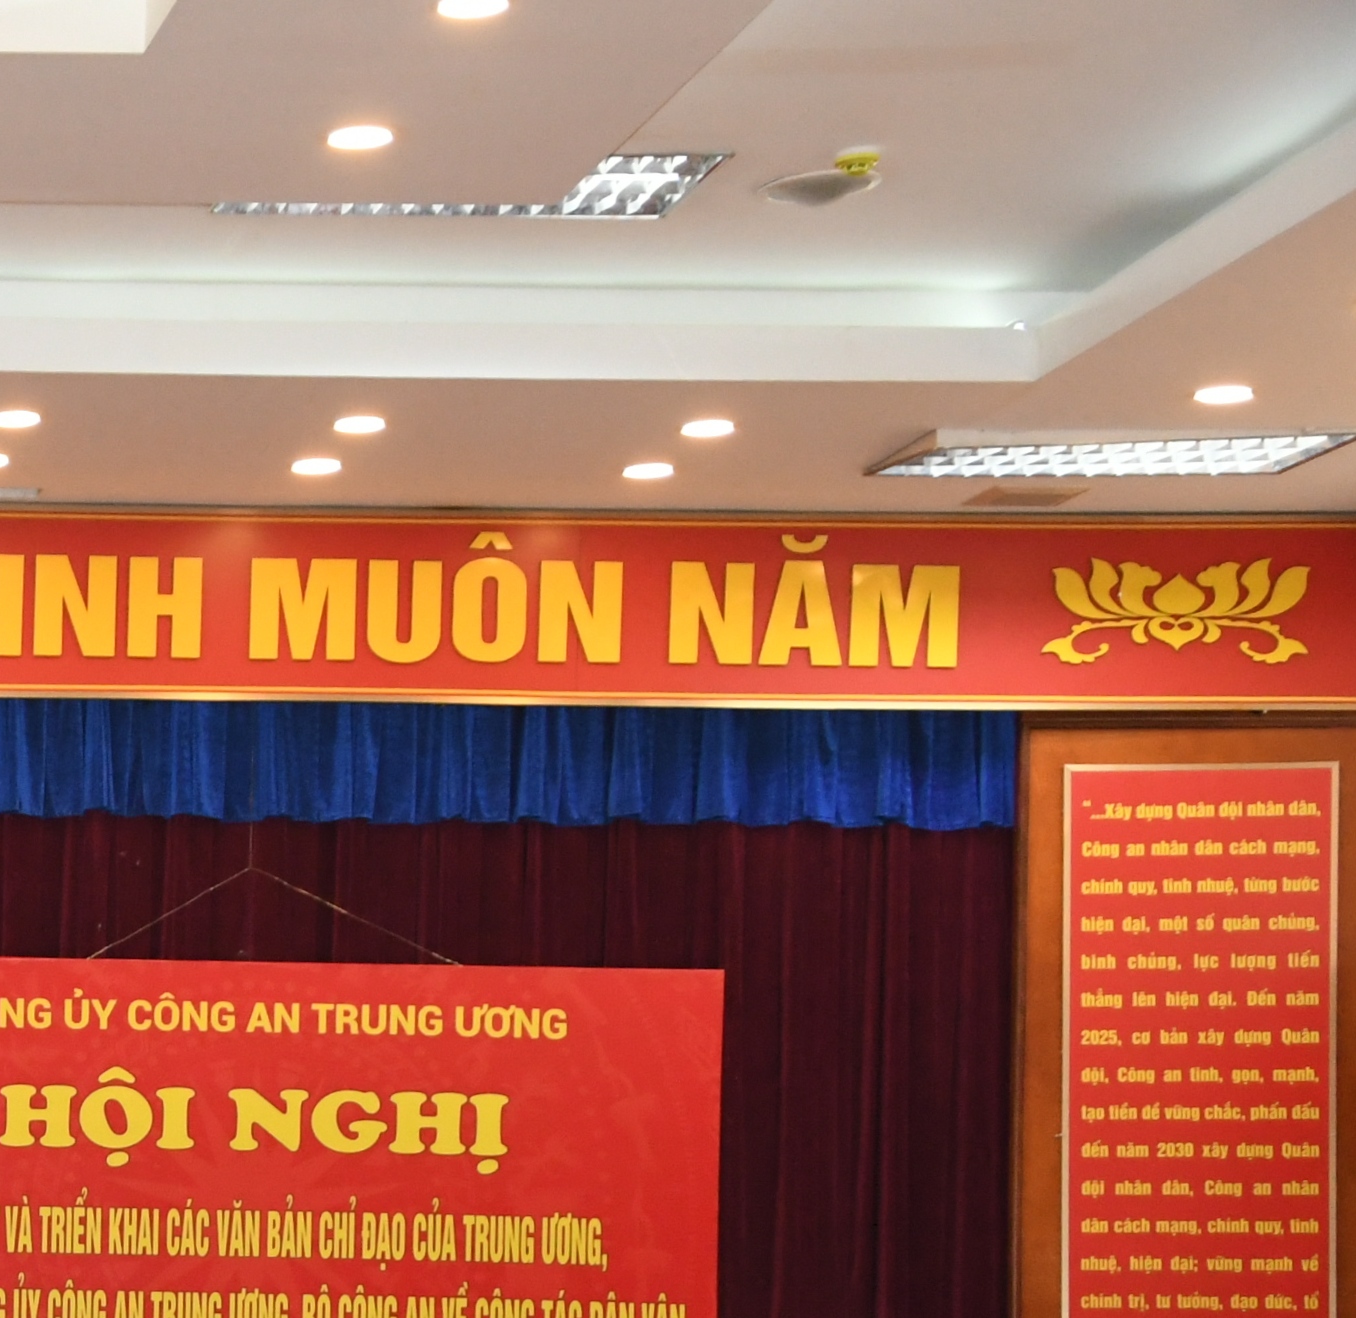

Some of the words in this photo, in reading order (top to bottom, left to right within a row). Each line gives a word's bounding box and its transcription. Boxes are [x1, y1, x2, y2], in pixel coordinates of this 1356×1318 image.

[248, 531, 623, 663] MUÔN
[668, 534, 961, 668] NĂM
[65, 989, 116, 1028] ỦY
[129, 993, 234, 1031] CÔNG
[248, 1003, 299, 1032] AN
[312, 1004, 442, 1035] TRUNG
[456, 1005, 566, 1038] ƯƠNG
[0, 1068, 194, 1166] HỘI
[229, 1090, 507, 1173] NGHỊ
[6, 1197, 31, 1252] VÀ
[40, 1188, 100, 1253] TRIỂN
[110, 1209, 158, 1254] KHAI
[168, 1200, 208, 1255] CÁC
[218, 1201, 259, 1256] VĂN
[268, 1196, 311, 1257] BẢN
[320, 1197, 355, 1258] CHỈ
[363, 1214, 404, 1269] ĐẠO
[414, 1199, 455, 1260] CỦA
[464, 1216, 533, 1262] TRUNG
[543, 1214, 606, 1270] ƯƠNG,
